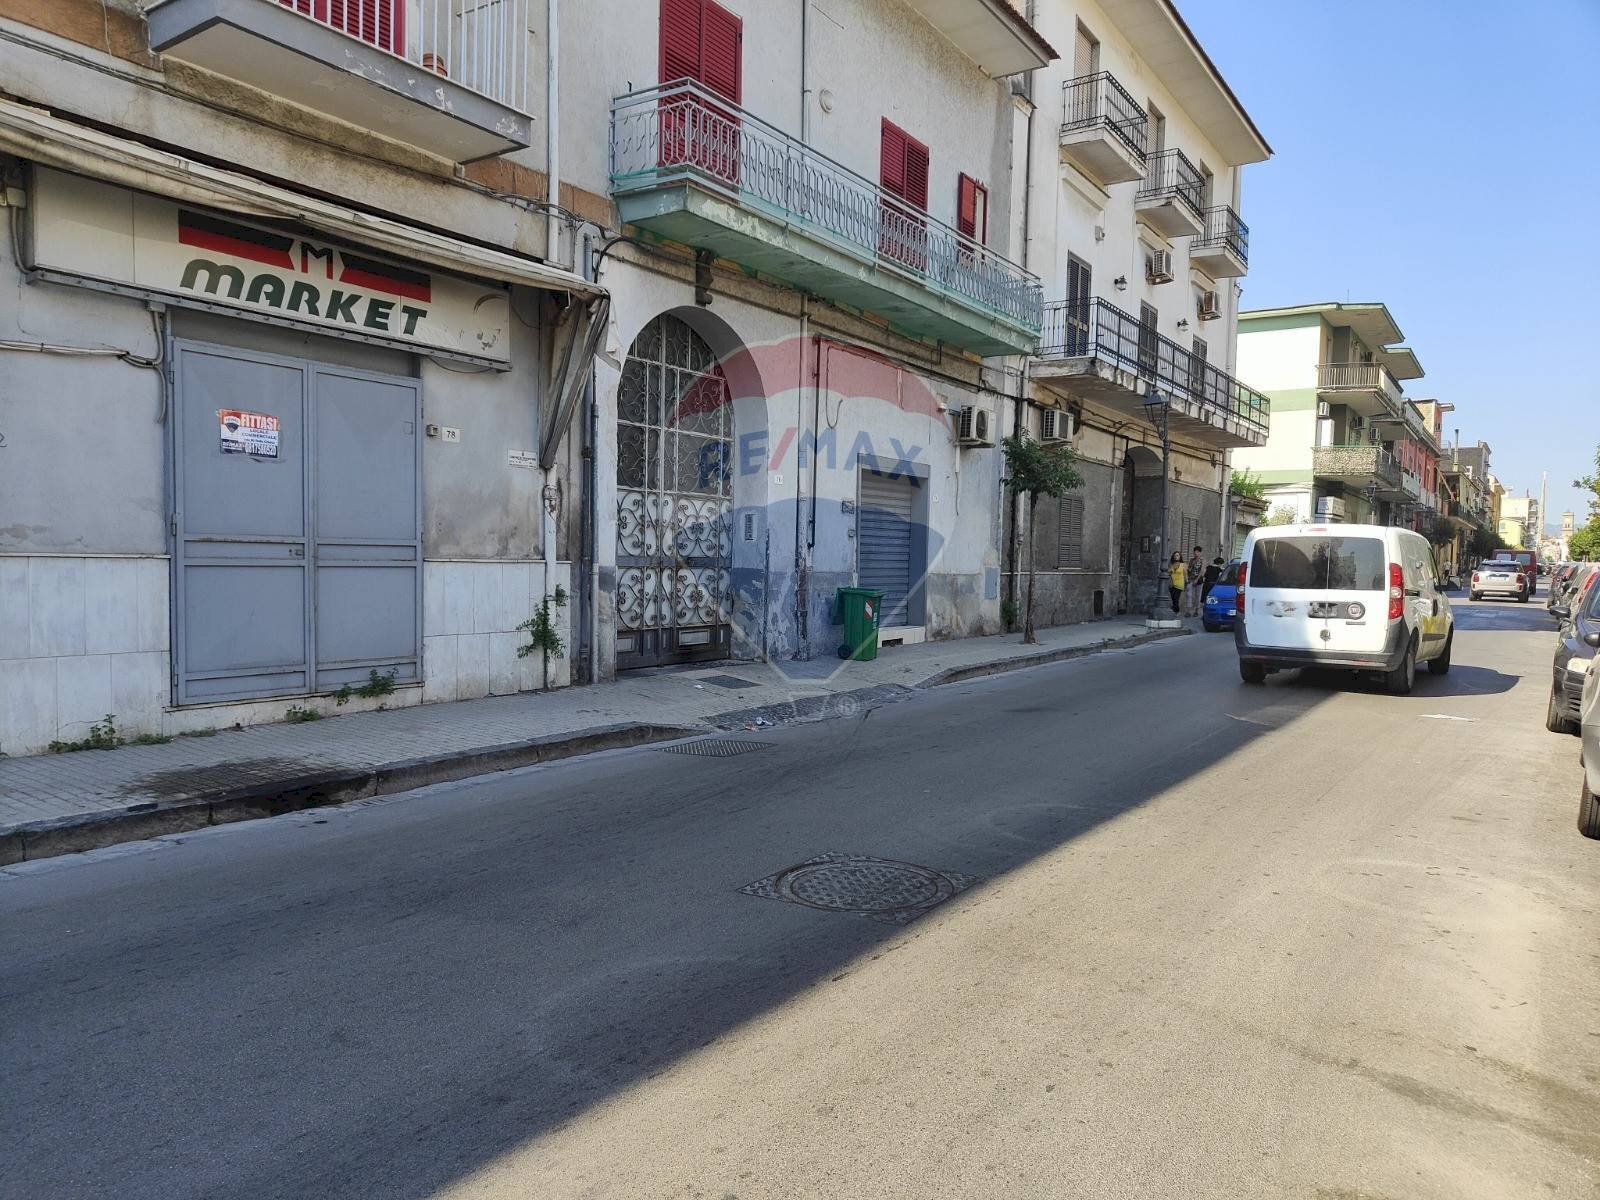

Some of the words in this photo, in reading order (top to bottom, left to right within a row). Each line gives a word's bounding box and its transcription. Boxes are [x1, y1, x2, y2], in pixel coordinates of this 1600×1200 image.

[179, 258, 428, 336] MARKET
[240, 413, 277, 431] FITTASI
[446, 430, 456, 439] 78
